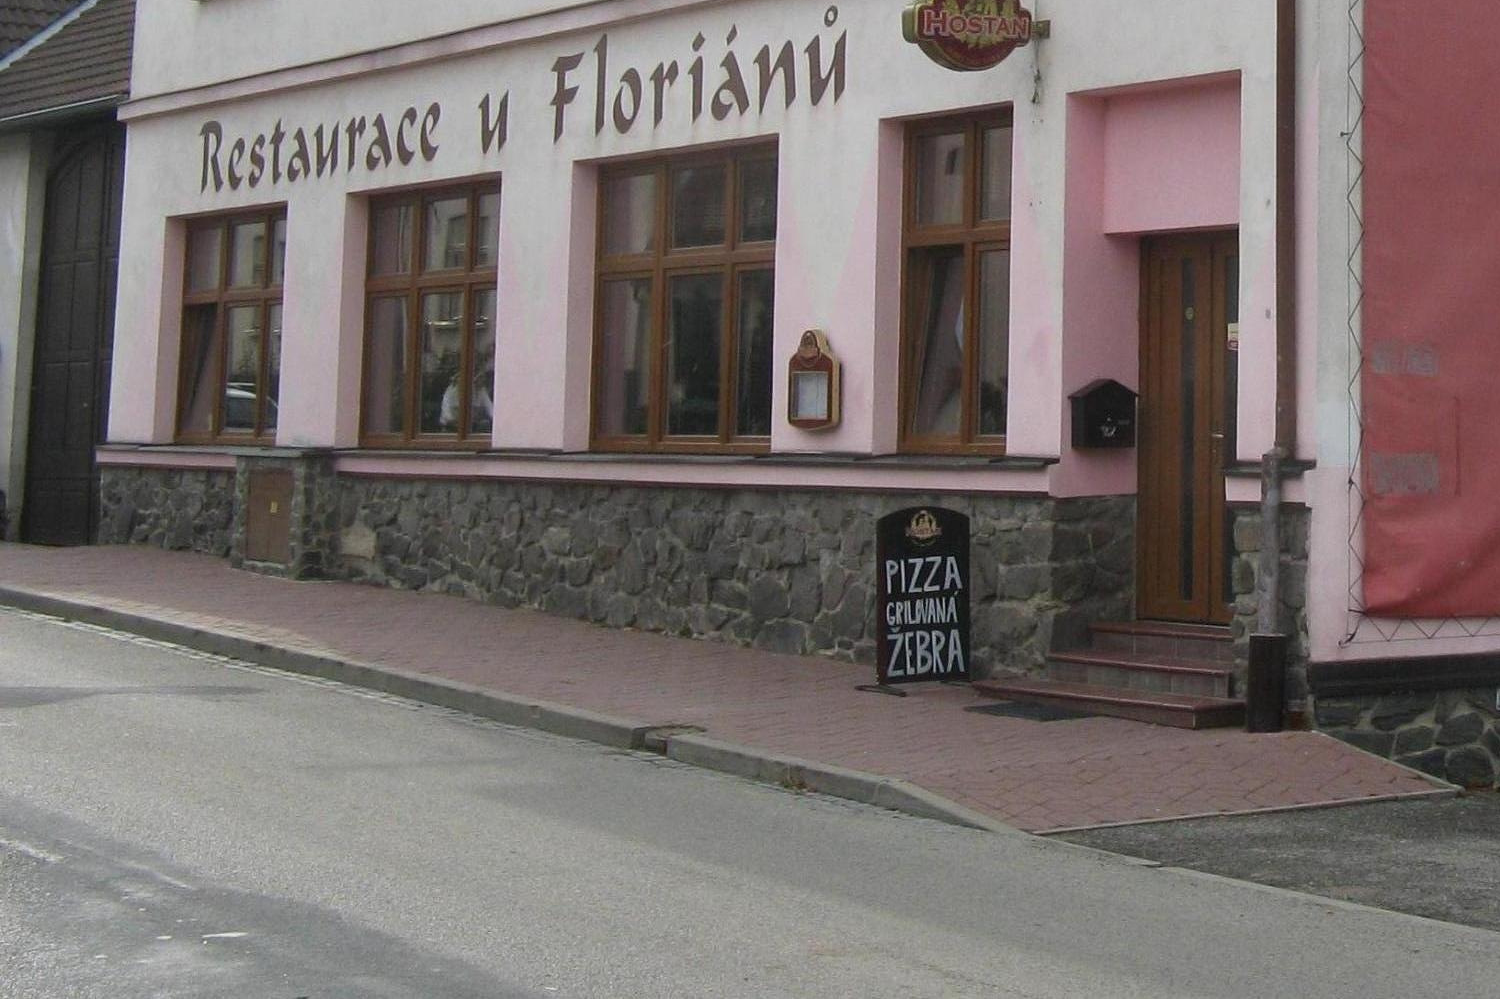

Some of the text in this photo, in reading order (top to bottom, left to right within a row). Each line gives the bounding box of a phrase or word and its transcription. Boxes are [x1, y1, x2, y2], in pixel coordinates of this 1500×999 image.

[923, 8, 1030, 38] HOSTAN
[199, 4, 848, 194] Restaurace u Floriánů
[885, 555, 963, 594] PIZZA
[886, 591, 960, 626] GRILOVANÁ
[887, 627, 965, 678] ŽEBRA
